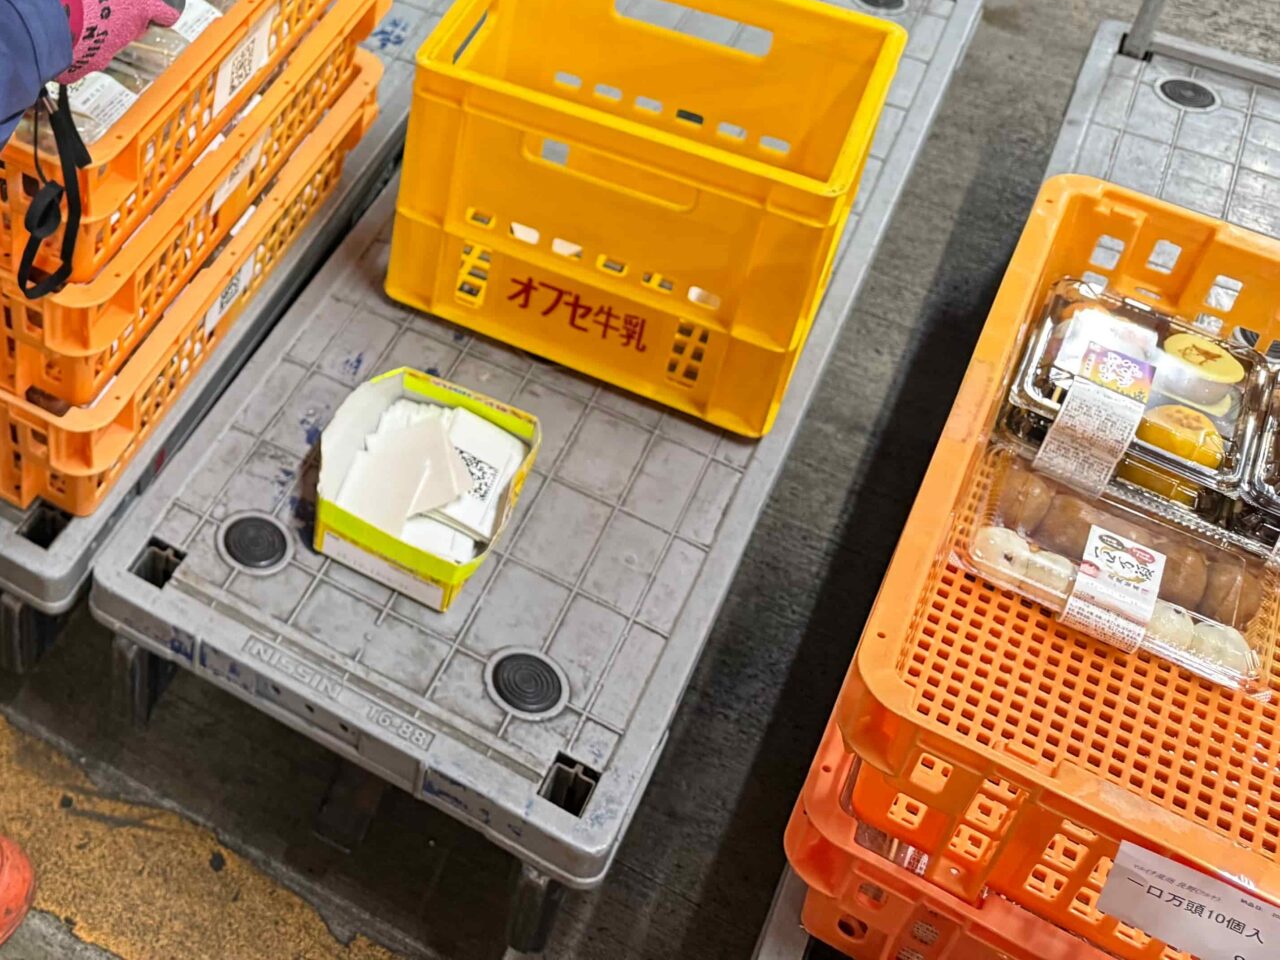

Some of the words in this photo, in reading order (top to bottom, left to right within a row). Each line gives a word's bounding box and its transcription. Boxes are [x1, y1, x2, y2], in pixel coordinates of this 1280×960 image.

[250, 641, 344, 700] NISSIN
[1126, 876, 1265, 945] 一口万頭10個入
